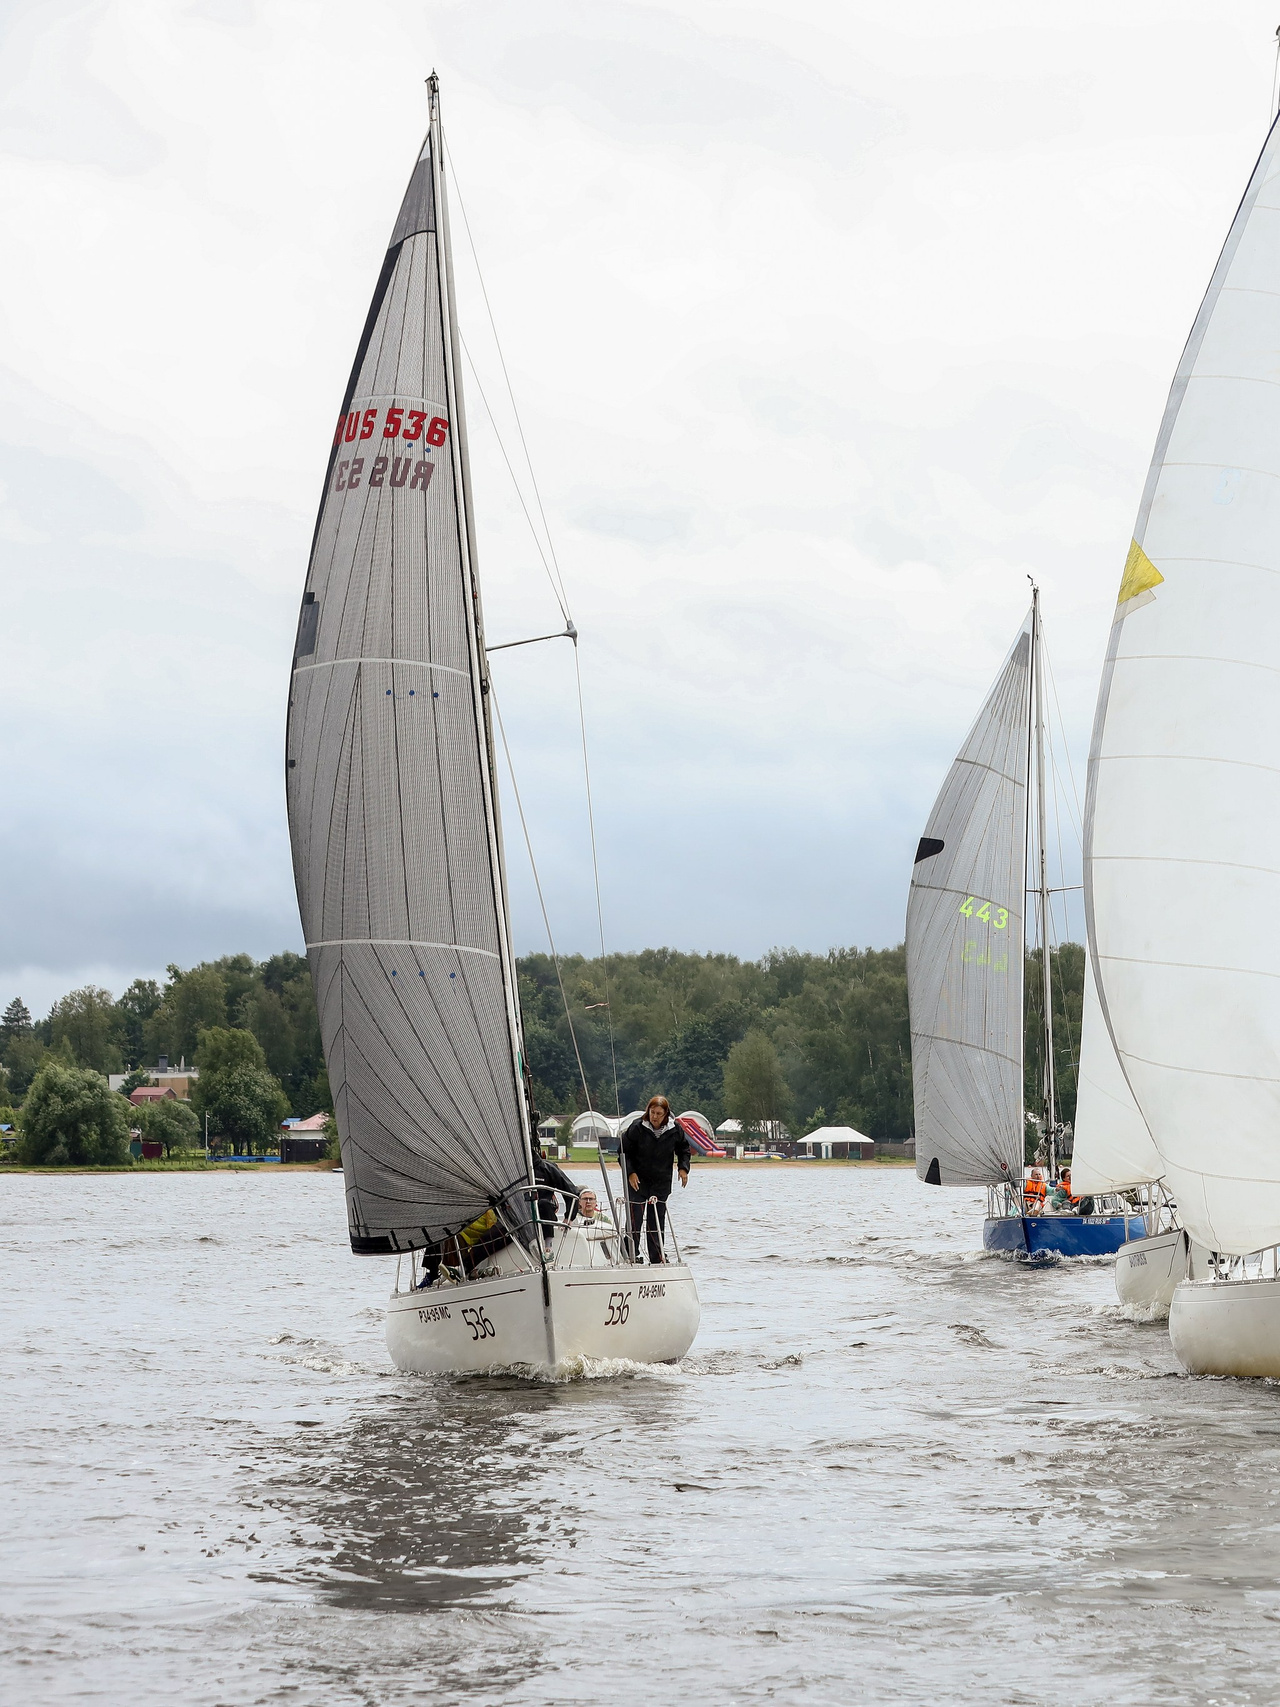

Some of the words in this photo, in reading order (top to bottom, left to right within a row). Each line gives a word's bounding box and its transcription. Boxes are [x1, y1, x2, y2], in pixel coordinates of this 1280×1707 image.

[383, 408, 449, 447] 536
[959, 896, 1009, 929] 443
[461, 1306, 496, 1341] 536
[603, 1291, 632, 1326] 536
